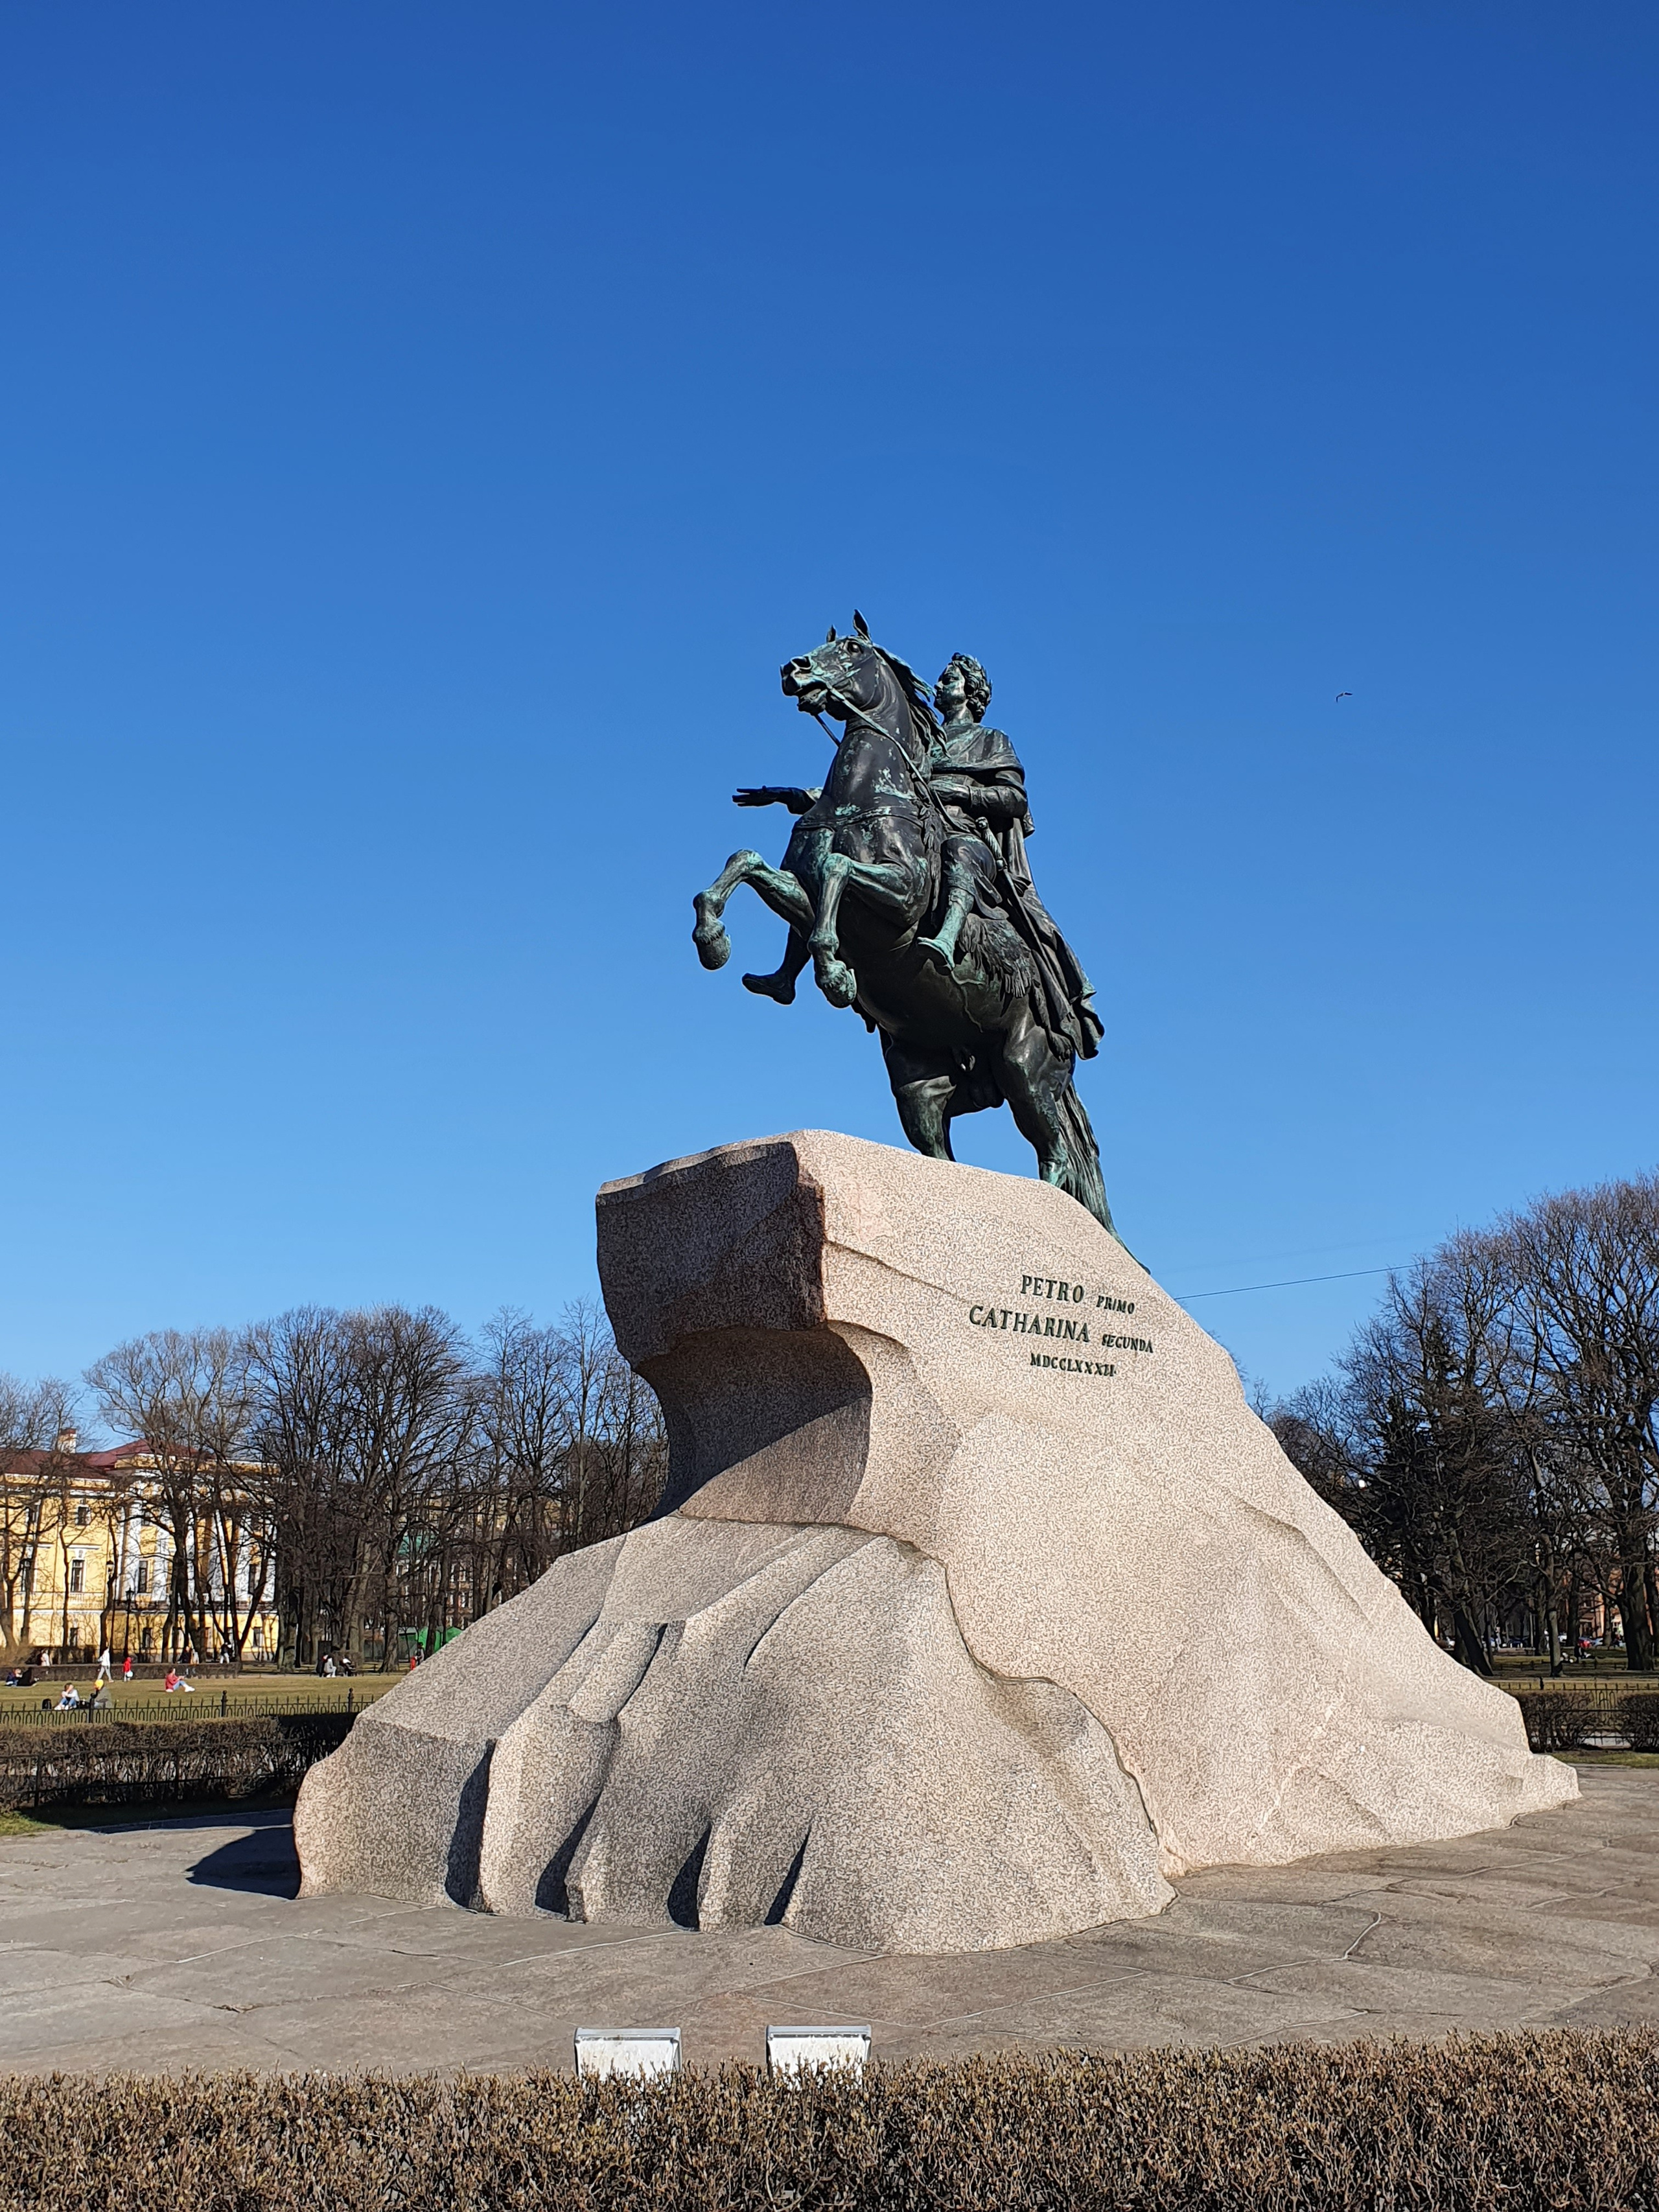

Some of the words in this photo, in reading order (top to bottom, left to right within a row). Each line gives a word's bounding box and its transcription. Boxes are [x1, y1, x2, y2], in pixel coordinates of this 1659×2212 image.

[1020, 1274, 1085, 1303] PETRO
[1096, 1295, 1135, 1314] PRIMO
[969, 1304, 1090, 1343] CATHARINA
[1102, 1334, 1154, 1353] SECUNDA
